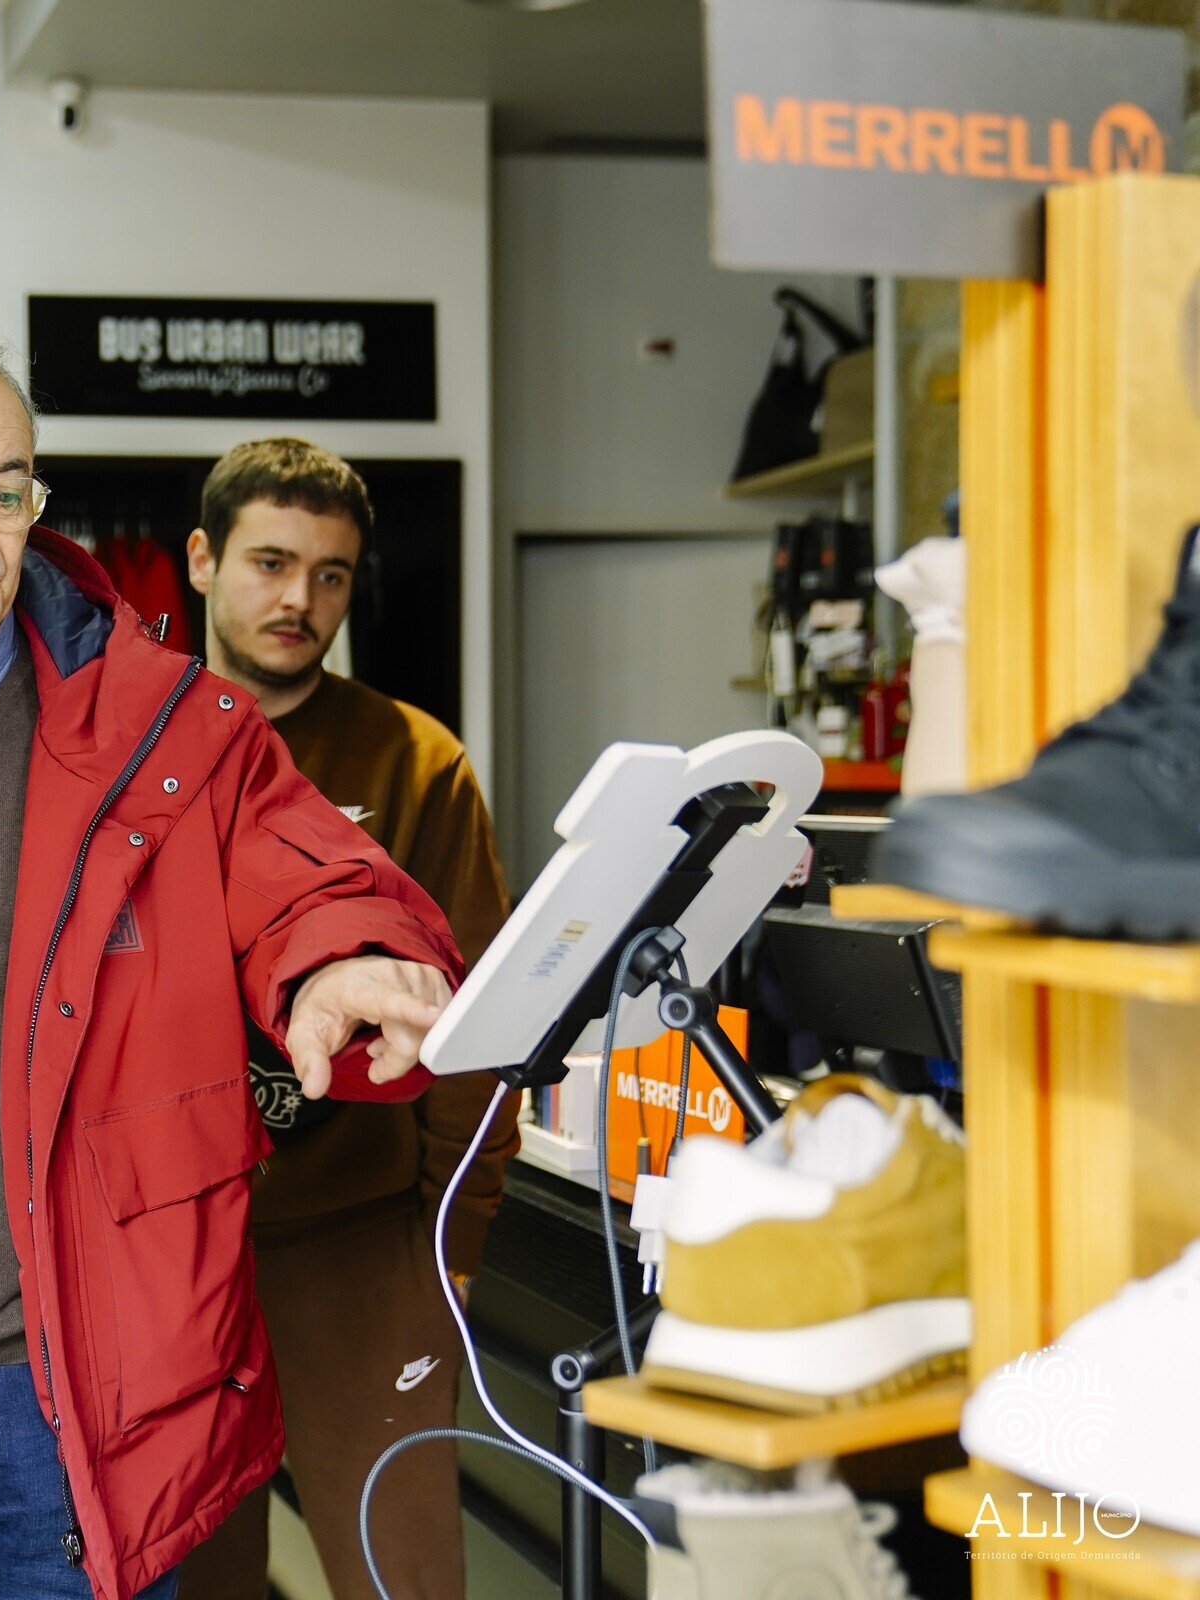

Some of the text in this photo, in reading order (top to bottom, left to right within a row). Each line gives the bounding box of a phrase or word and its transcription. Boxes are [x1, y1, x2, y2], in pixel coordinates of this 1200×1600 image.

[734, 93, 1090, 182] MERRELL
[99, 316, 365, 365] BUS URBAN WEAR
